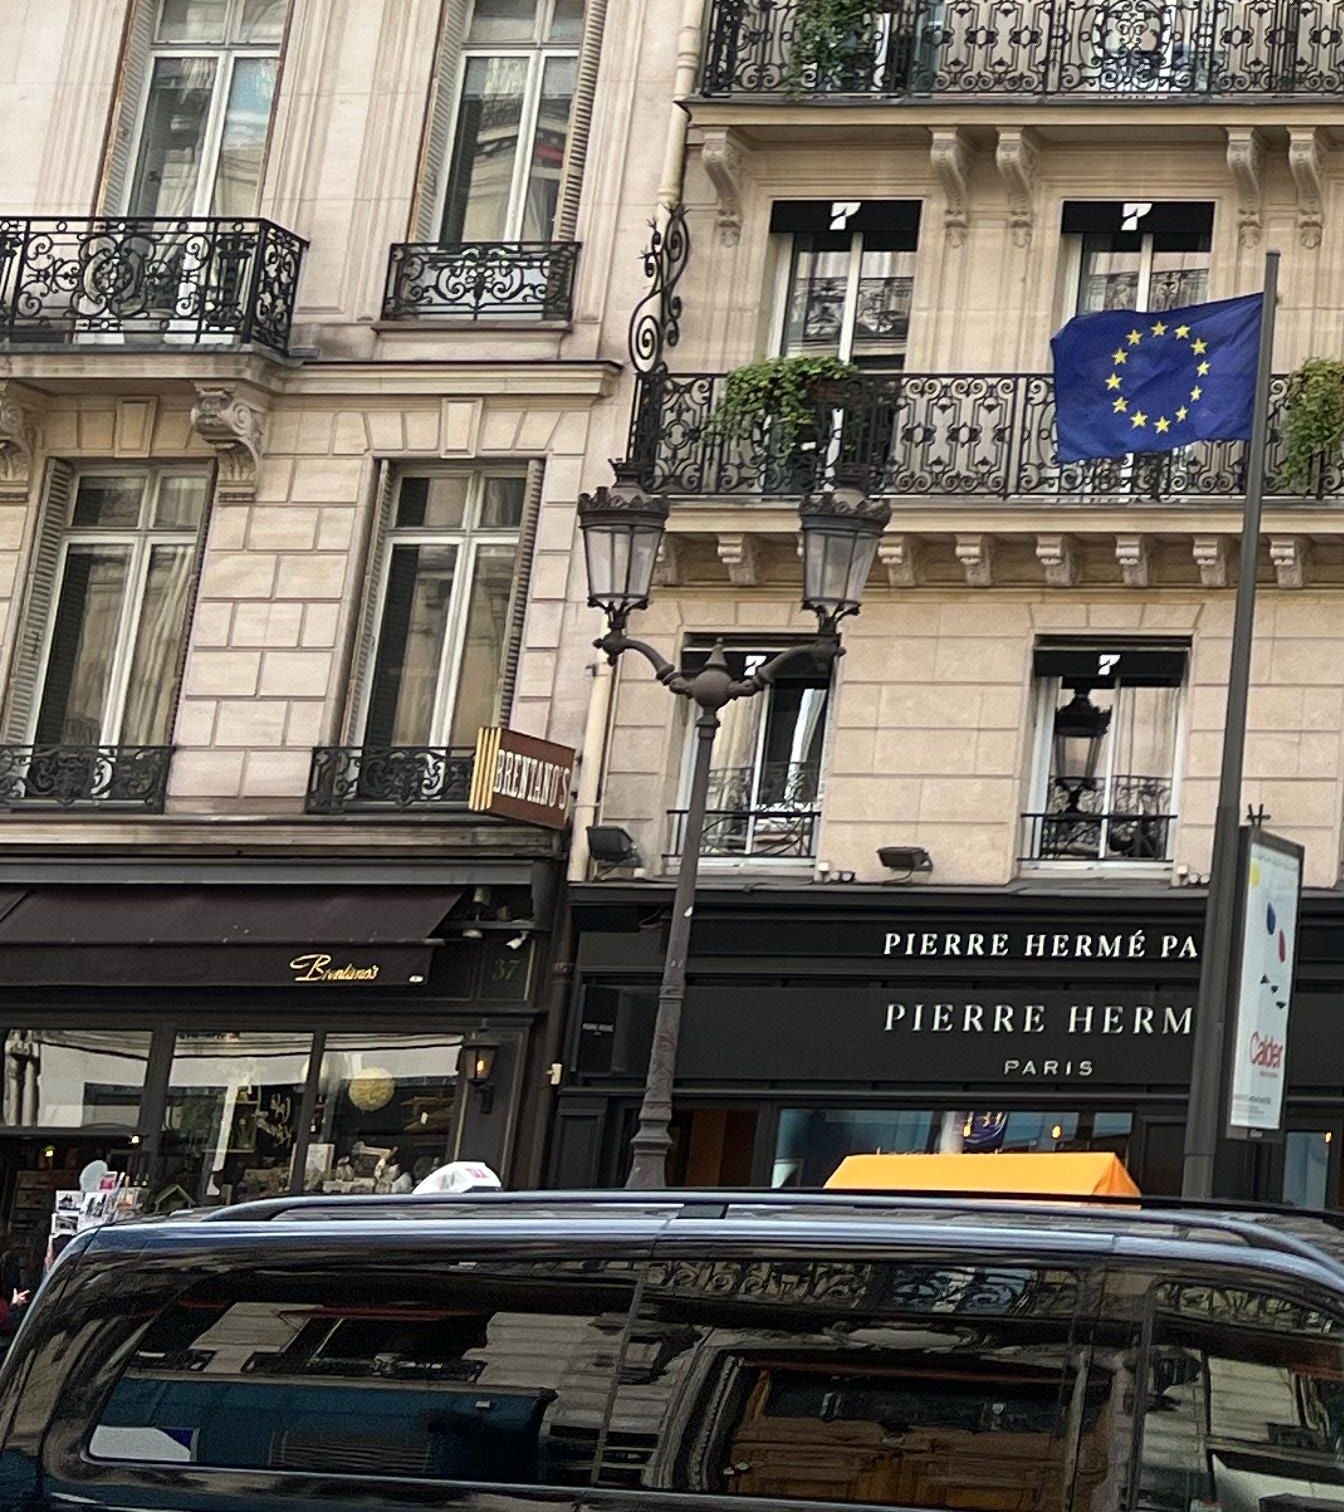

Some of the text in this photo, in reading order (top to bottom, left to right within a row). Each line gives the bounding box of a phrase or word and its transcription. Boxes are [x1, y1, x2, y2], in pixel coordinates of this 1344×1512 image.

[492, 748, 570, 810] BRENTANO'S
[883, 929, 1199, 958] PIERRE HERMÉ PA
[289, 953, 380, 982] Brentano's
[491, 959, 521, 981] 37
[883, 1003, 1194, 1035] PIERRE HERM
[1003, 1058, 1094, 1077] PARIS
